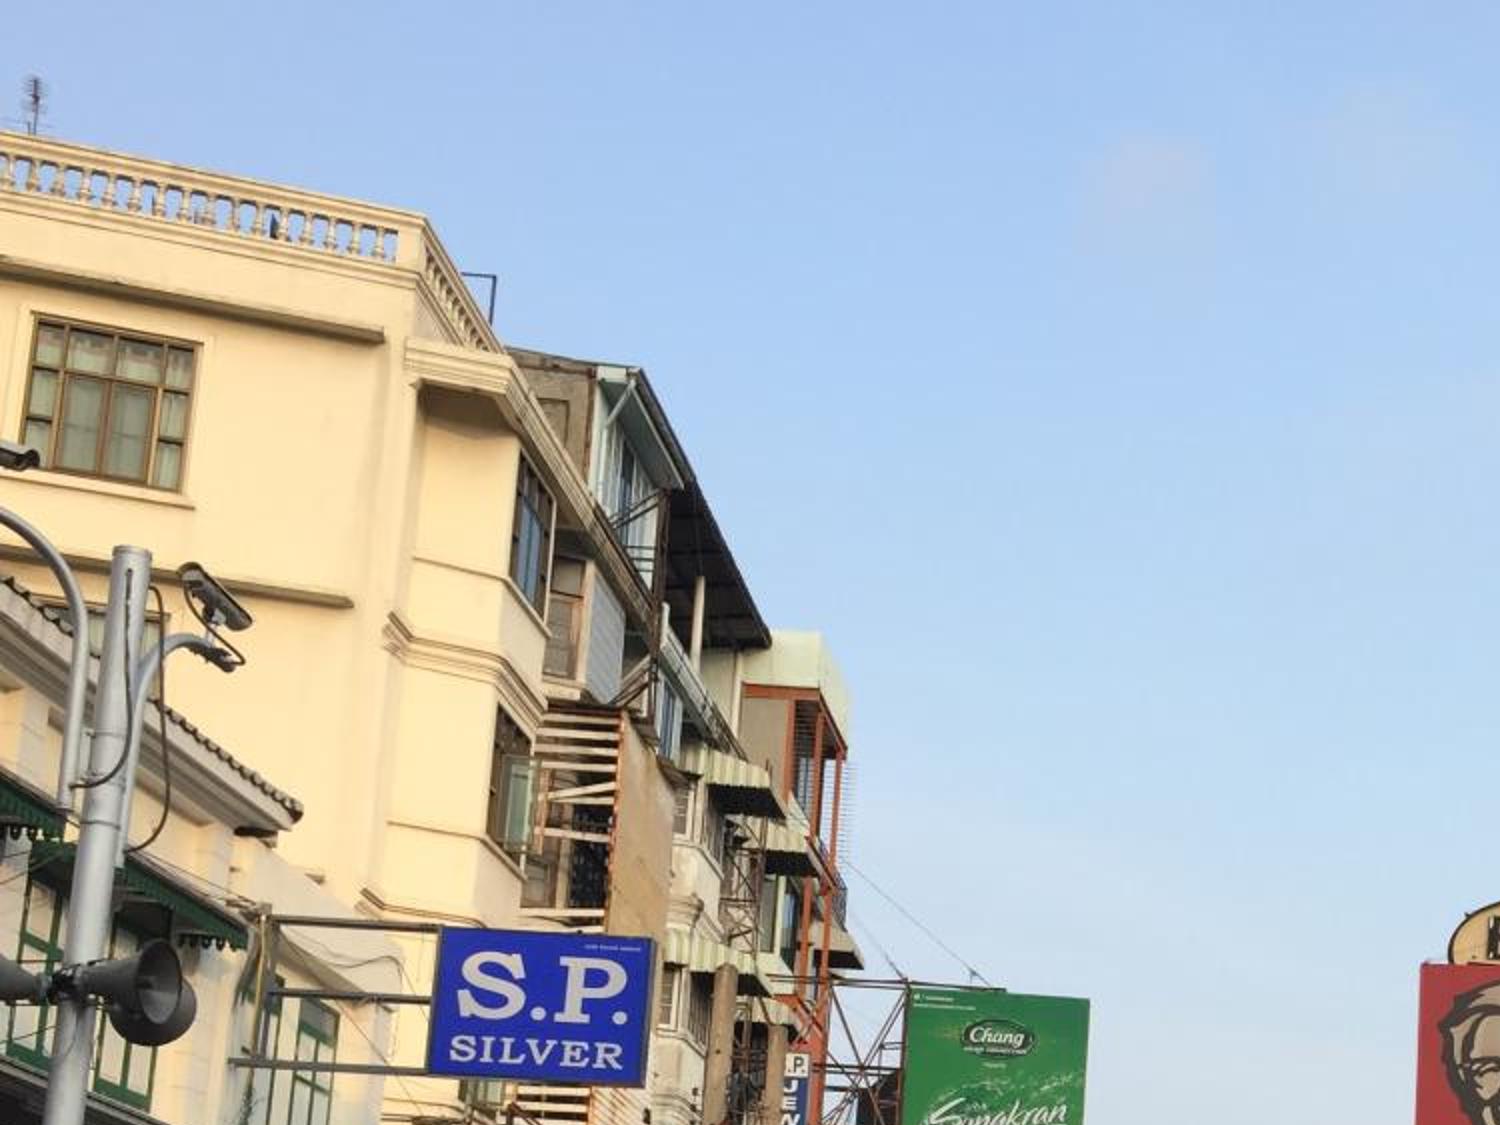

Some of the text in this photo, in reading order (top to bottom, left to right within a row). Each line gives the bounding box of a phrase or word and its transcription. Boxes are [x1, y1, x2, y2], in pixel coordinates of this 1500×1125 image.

[457, 951, 628, 1025] S.P.
[450, 1034, 623, 1070] SILVER
[969, 1026, 1026, 1049] Chang
